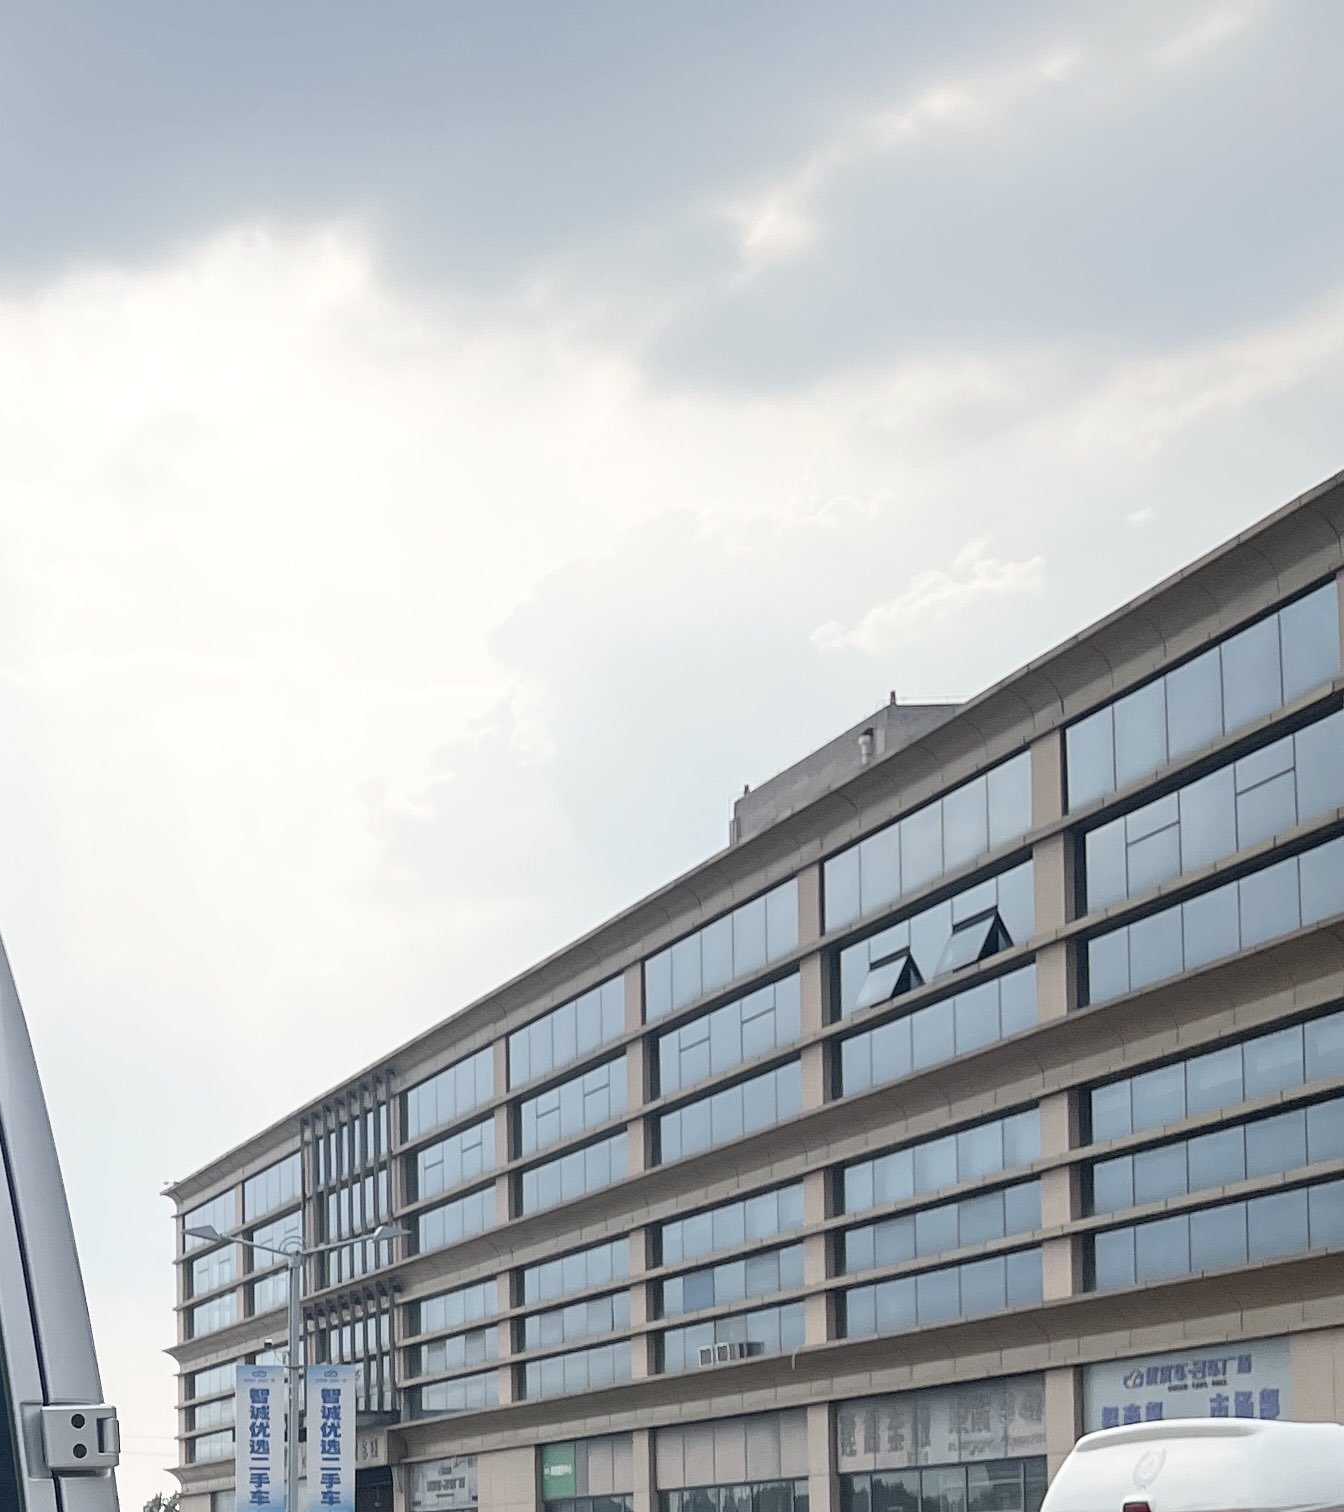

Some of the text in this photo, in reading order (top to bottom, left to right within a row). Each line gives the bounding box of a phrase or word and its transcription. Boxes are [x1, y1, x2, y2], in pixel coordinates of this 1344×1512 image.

[249, 1388, 271, 1506] 智诚优选二手车
[320, 1388, 342, 1506] 智诚优选二手车
